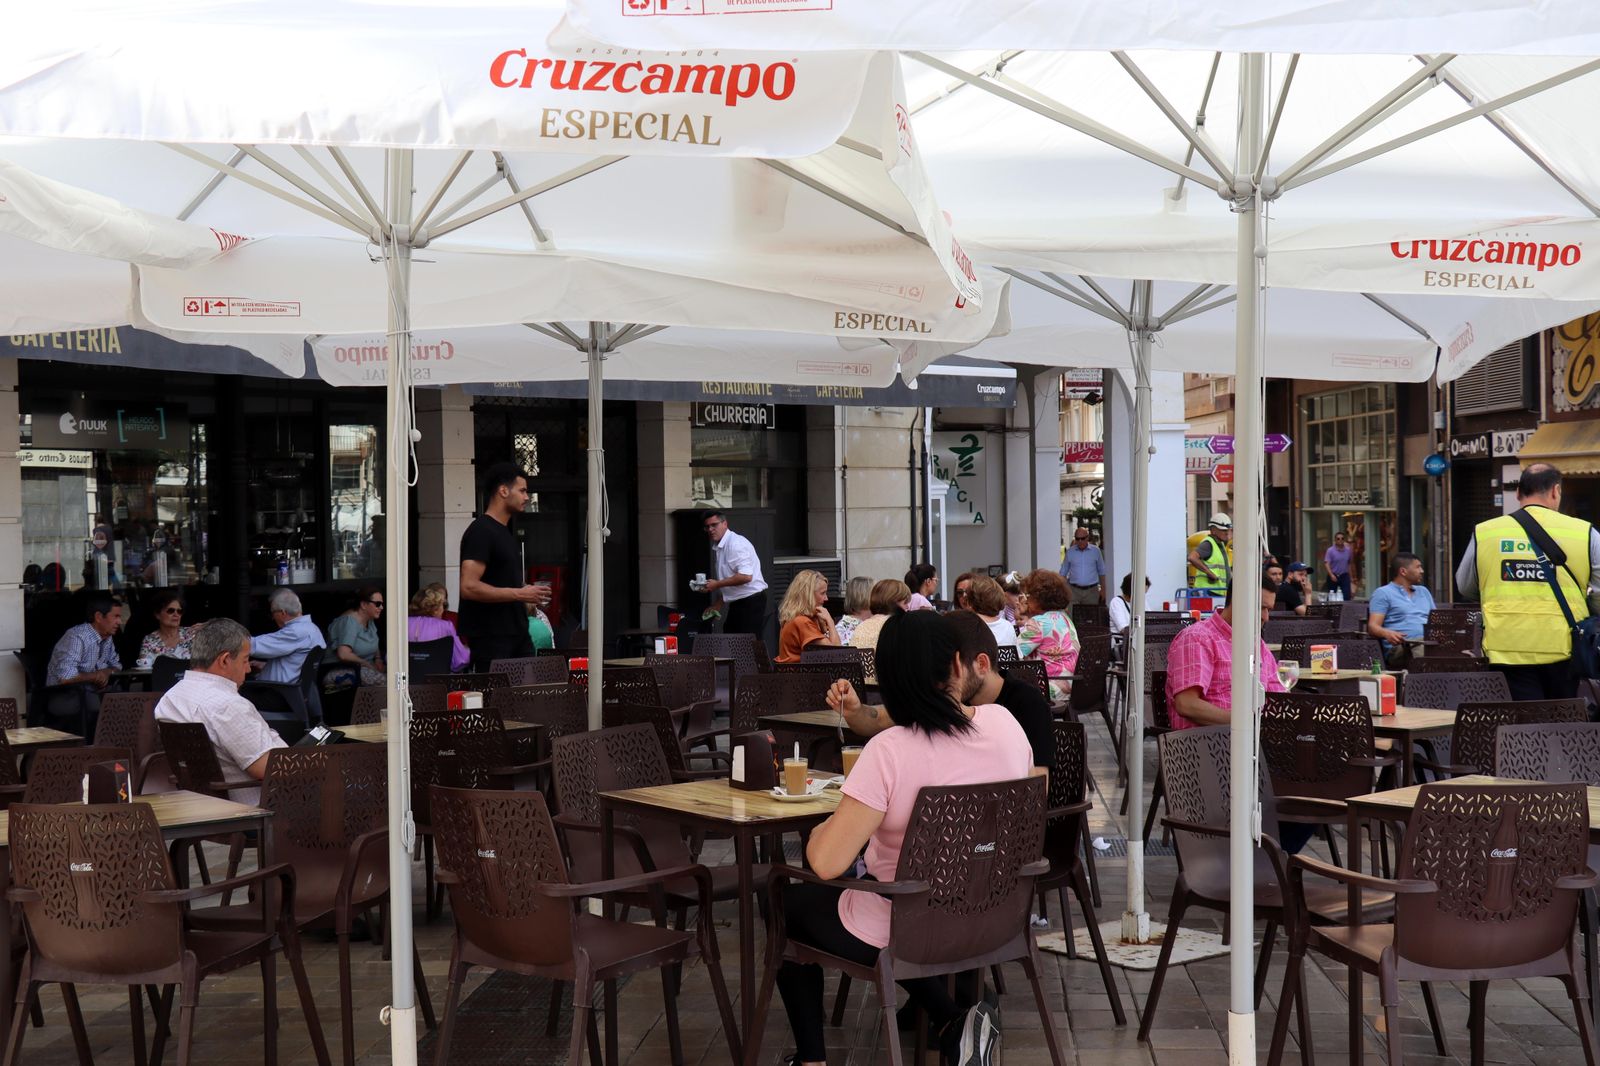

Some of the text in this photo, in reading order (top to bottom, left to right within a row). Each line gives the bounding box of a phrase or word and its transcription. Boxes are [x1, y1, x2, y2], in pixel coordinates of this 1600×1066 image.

[489, 48, 796, 107] Cruzcampo
[539, 107, 722, 146] ESPECIAL
[1390, 239, 1581, 271] Cruzcampo
[1423, 270, 1535, 290] ESPECIAL
[833, 311, 932, 333] ESPECIAL
[702, 381, 773, 396] RESTAURANTE
[704, 403, 767, 425] CHURRERÍA
[1065, 442, 1103, 455] PELUQU
[1515, 570, 1545, 579] ONC
[1490, 848, 1519, 858] Coca-Cola
